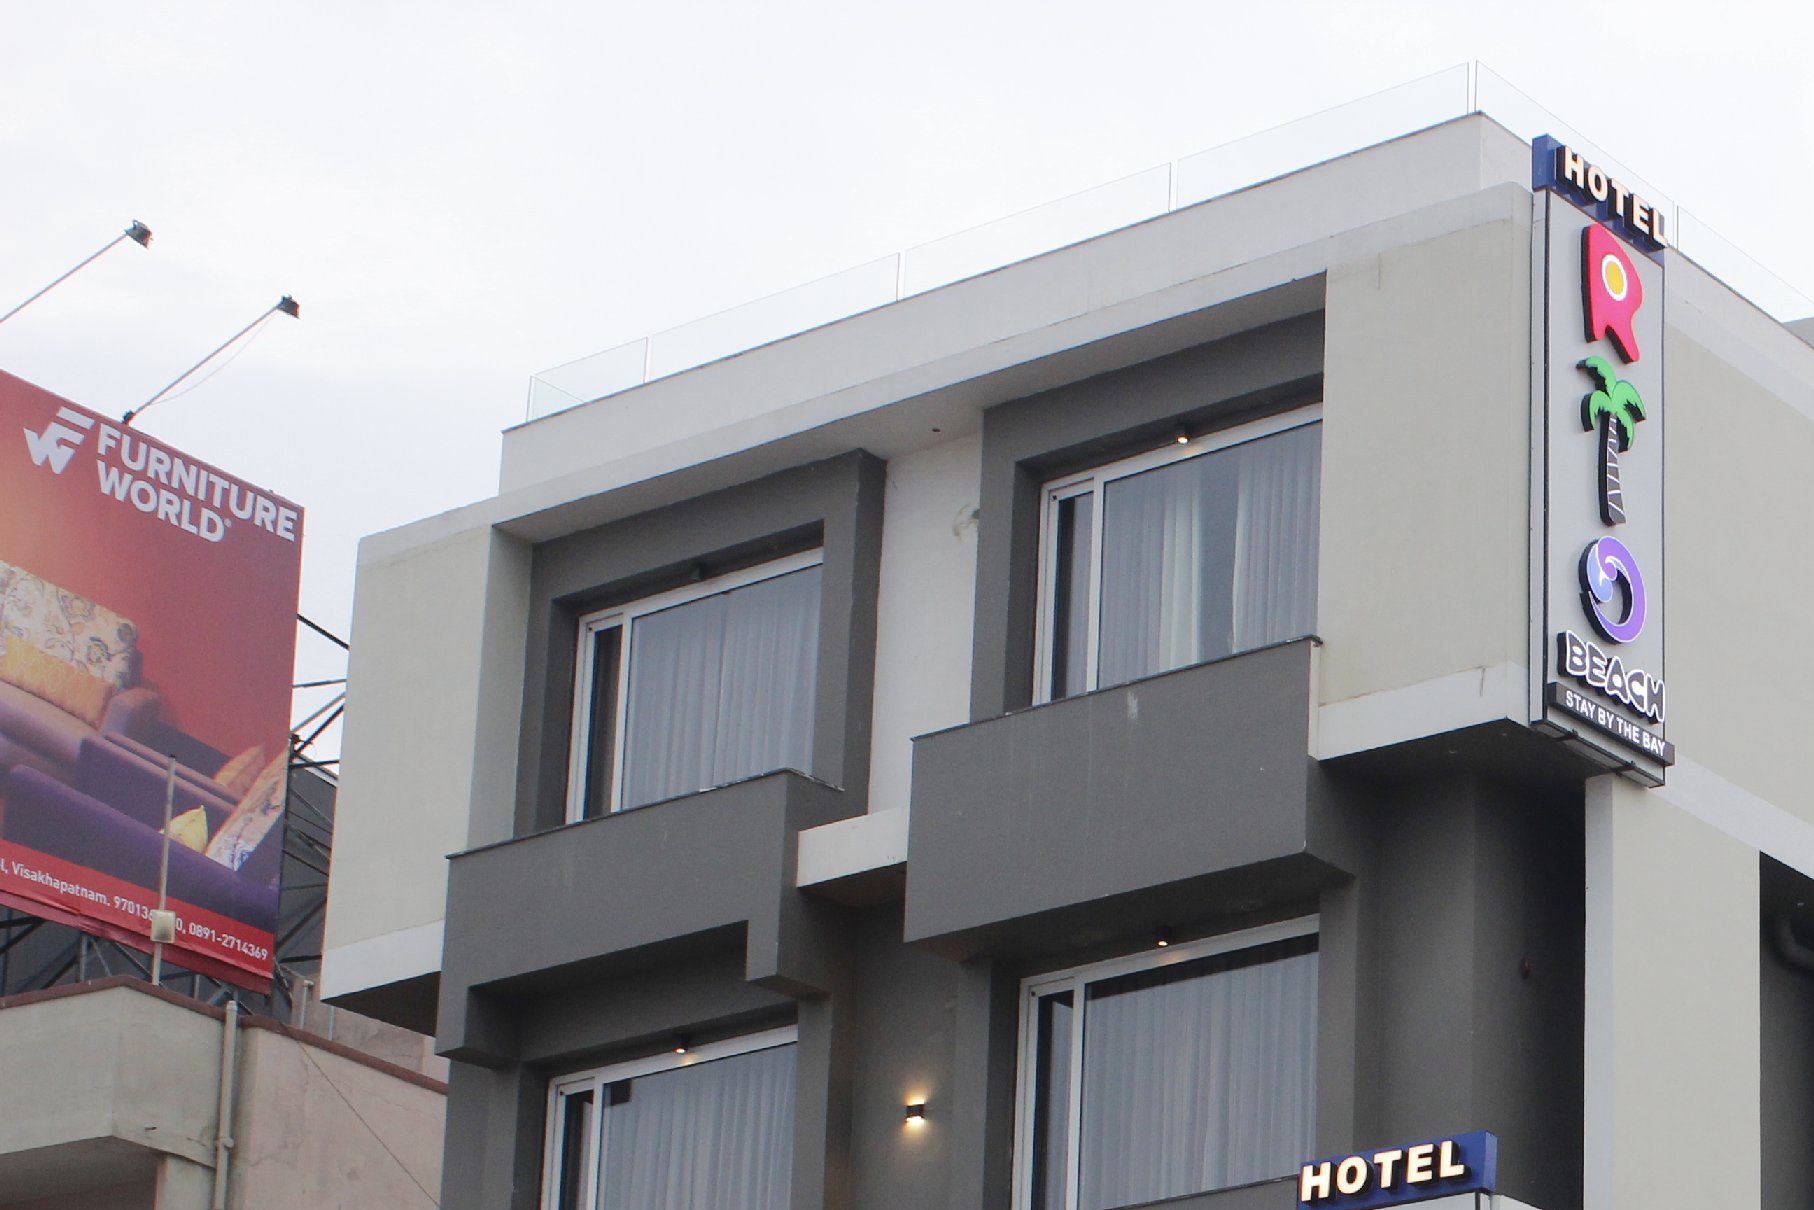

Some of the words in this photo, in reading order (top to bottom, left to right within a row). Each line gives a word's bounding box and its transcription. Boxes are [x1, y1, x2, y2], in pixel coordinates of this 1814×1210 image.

[1563, 145, 1669, 249] HOTEL
[96, 459, 226, 543] WORLD
[97, 422, 298, 542] FURNITURE
[1565, 630, 1666, 723] BEACH
[1566, 690, 1596, 720] STAY
[1597, 707, 1615, 729] BY
[1616, 716, 1640, 744] THE
[1642, 730, 1666, 757] BAY
[11, 860, 111, 906] Visakhapatnam.
[188, 921, 268, 961] 0891-2714369
[1301, 1140, 1465, 1202] HOTEL
